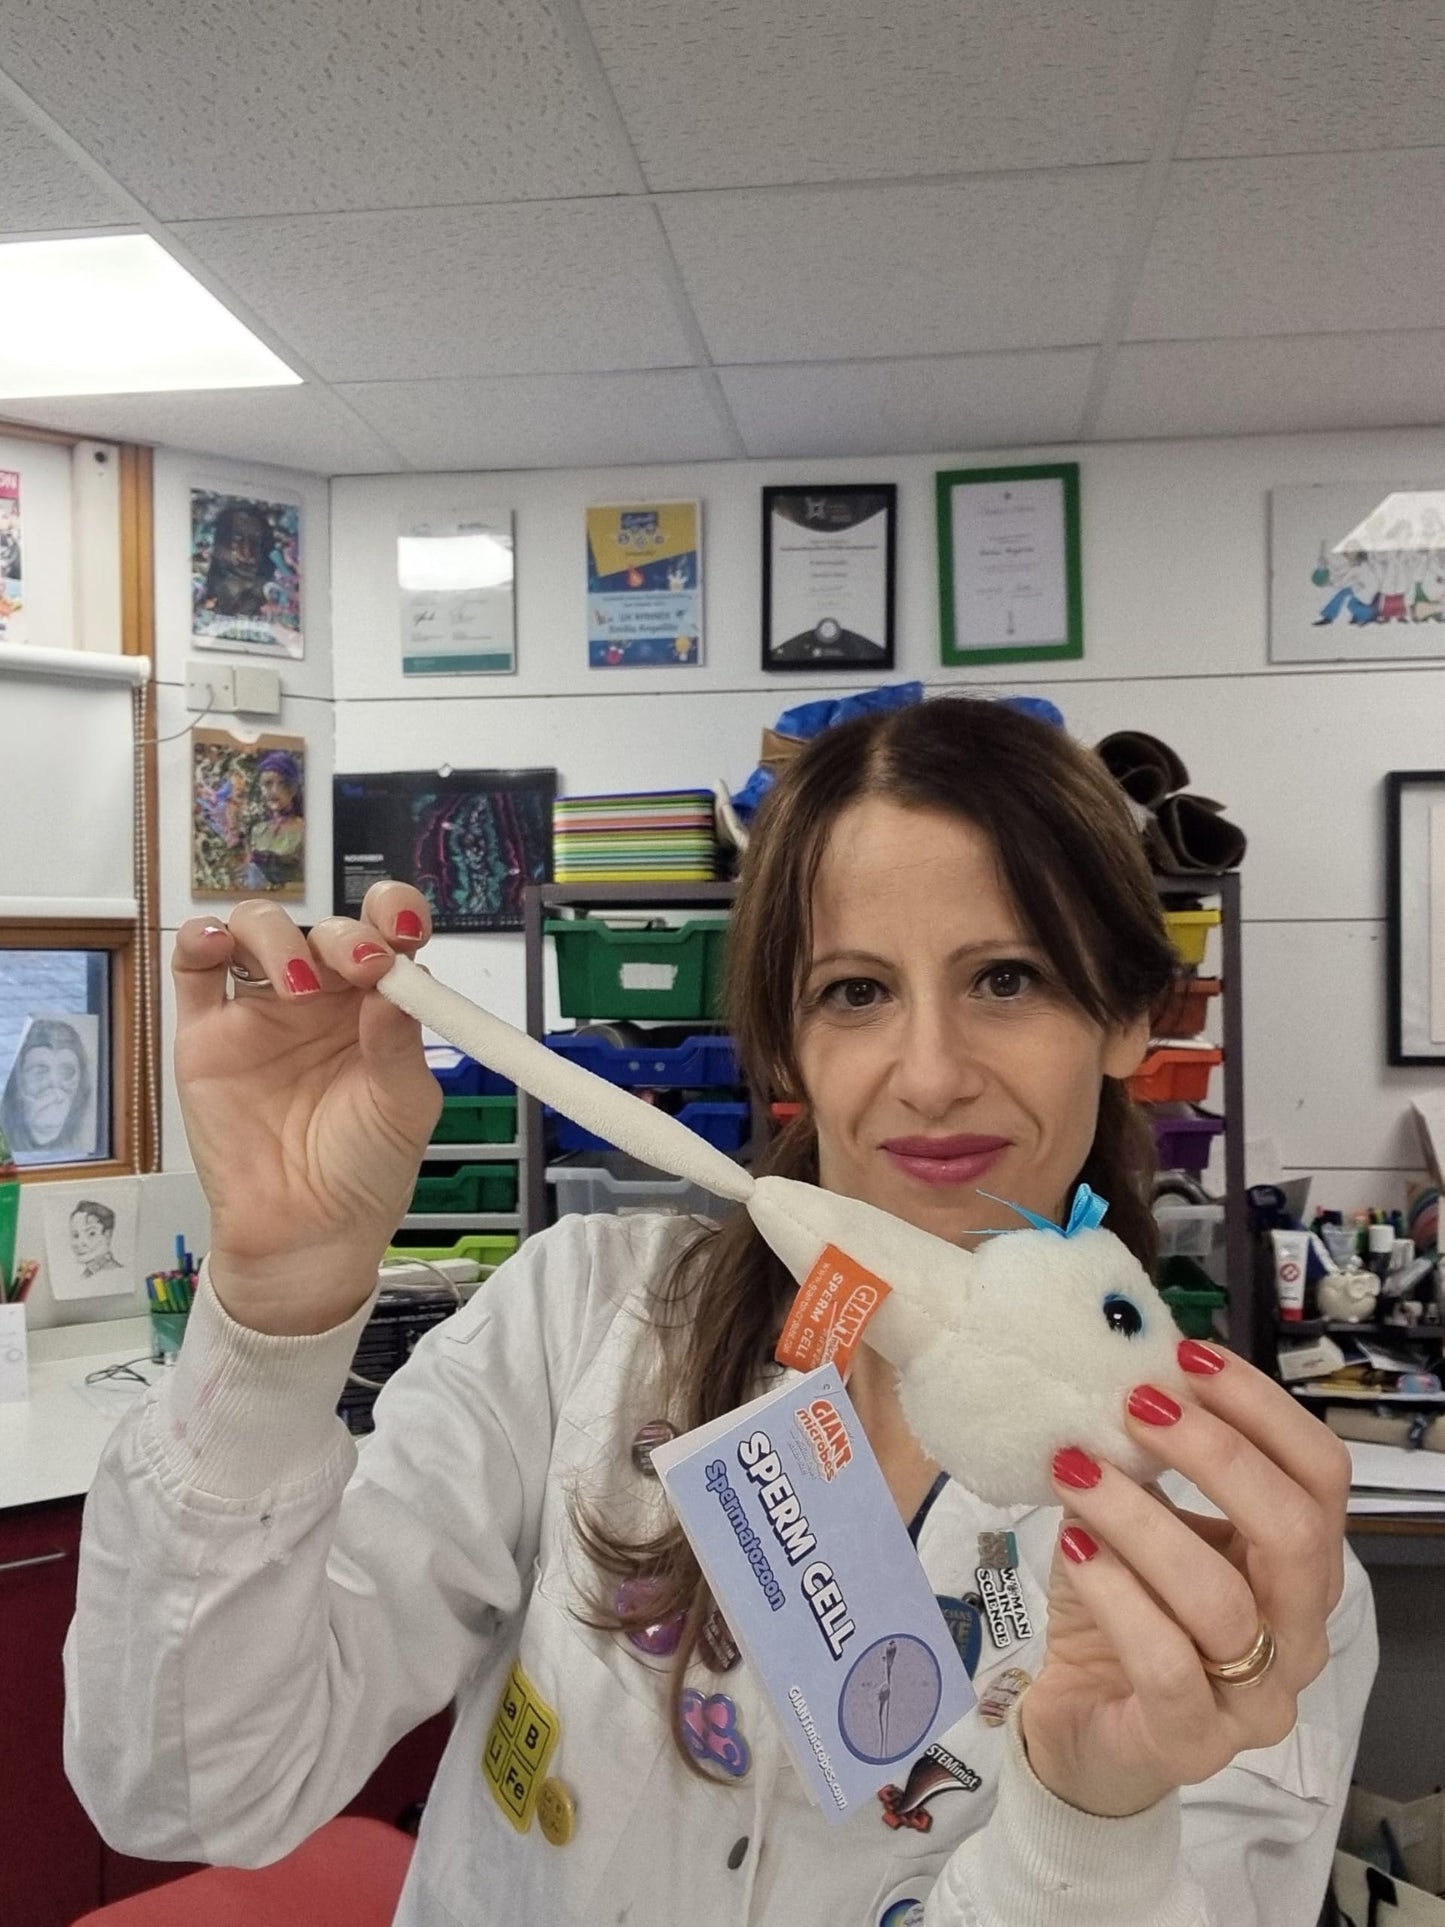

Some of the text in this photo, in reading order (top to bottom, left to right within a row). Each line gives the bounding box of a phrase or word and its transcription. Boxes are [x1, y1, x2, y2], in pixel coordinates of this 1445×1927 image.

[811, 1272, 843, 1323] SPERM
[832, 1285, 878, 1348] GIANT
[795, 1328, 815, 1359] CELL
[795, 1409, 835, 1482] microbes
[809, 1399, 853, 1469] GIANT
[738, 1431, 817, 1566] SPERM
[801, 1561, 856, 1661] CELL
[979, 1569, 1009, 1646] SCIENCE
[999, 1592, 1012, 1615] IN
[525, 1723, 539, 1749] B
[788, 1685, 848, 1810] GIANTmicrobes.com
[505, 1766, 525, 1800] Fe
[926, 1745, 978, 1788] STEMinist
